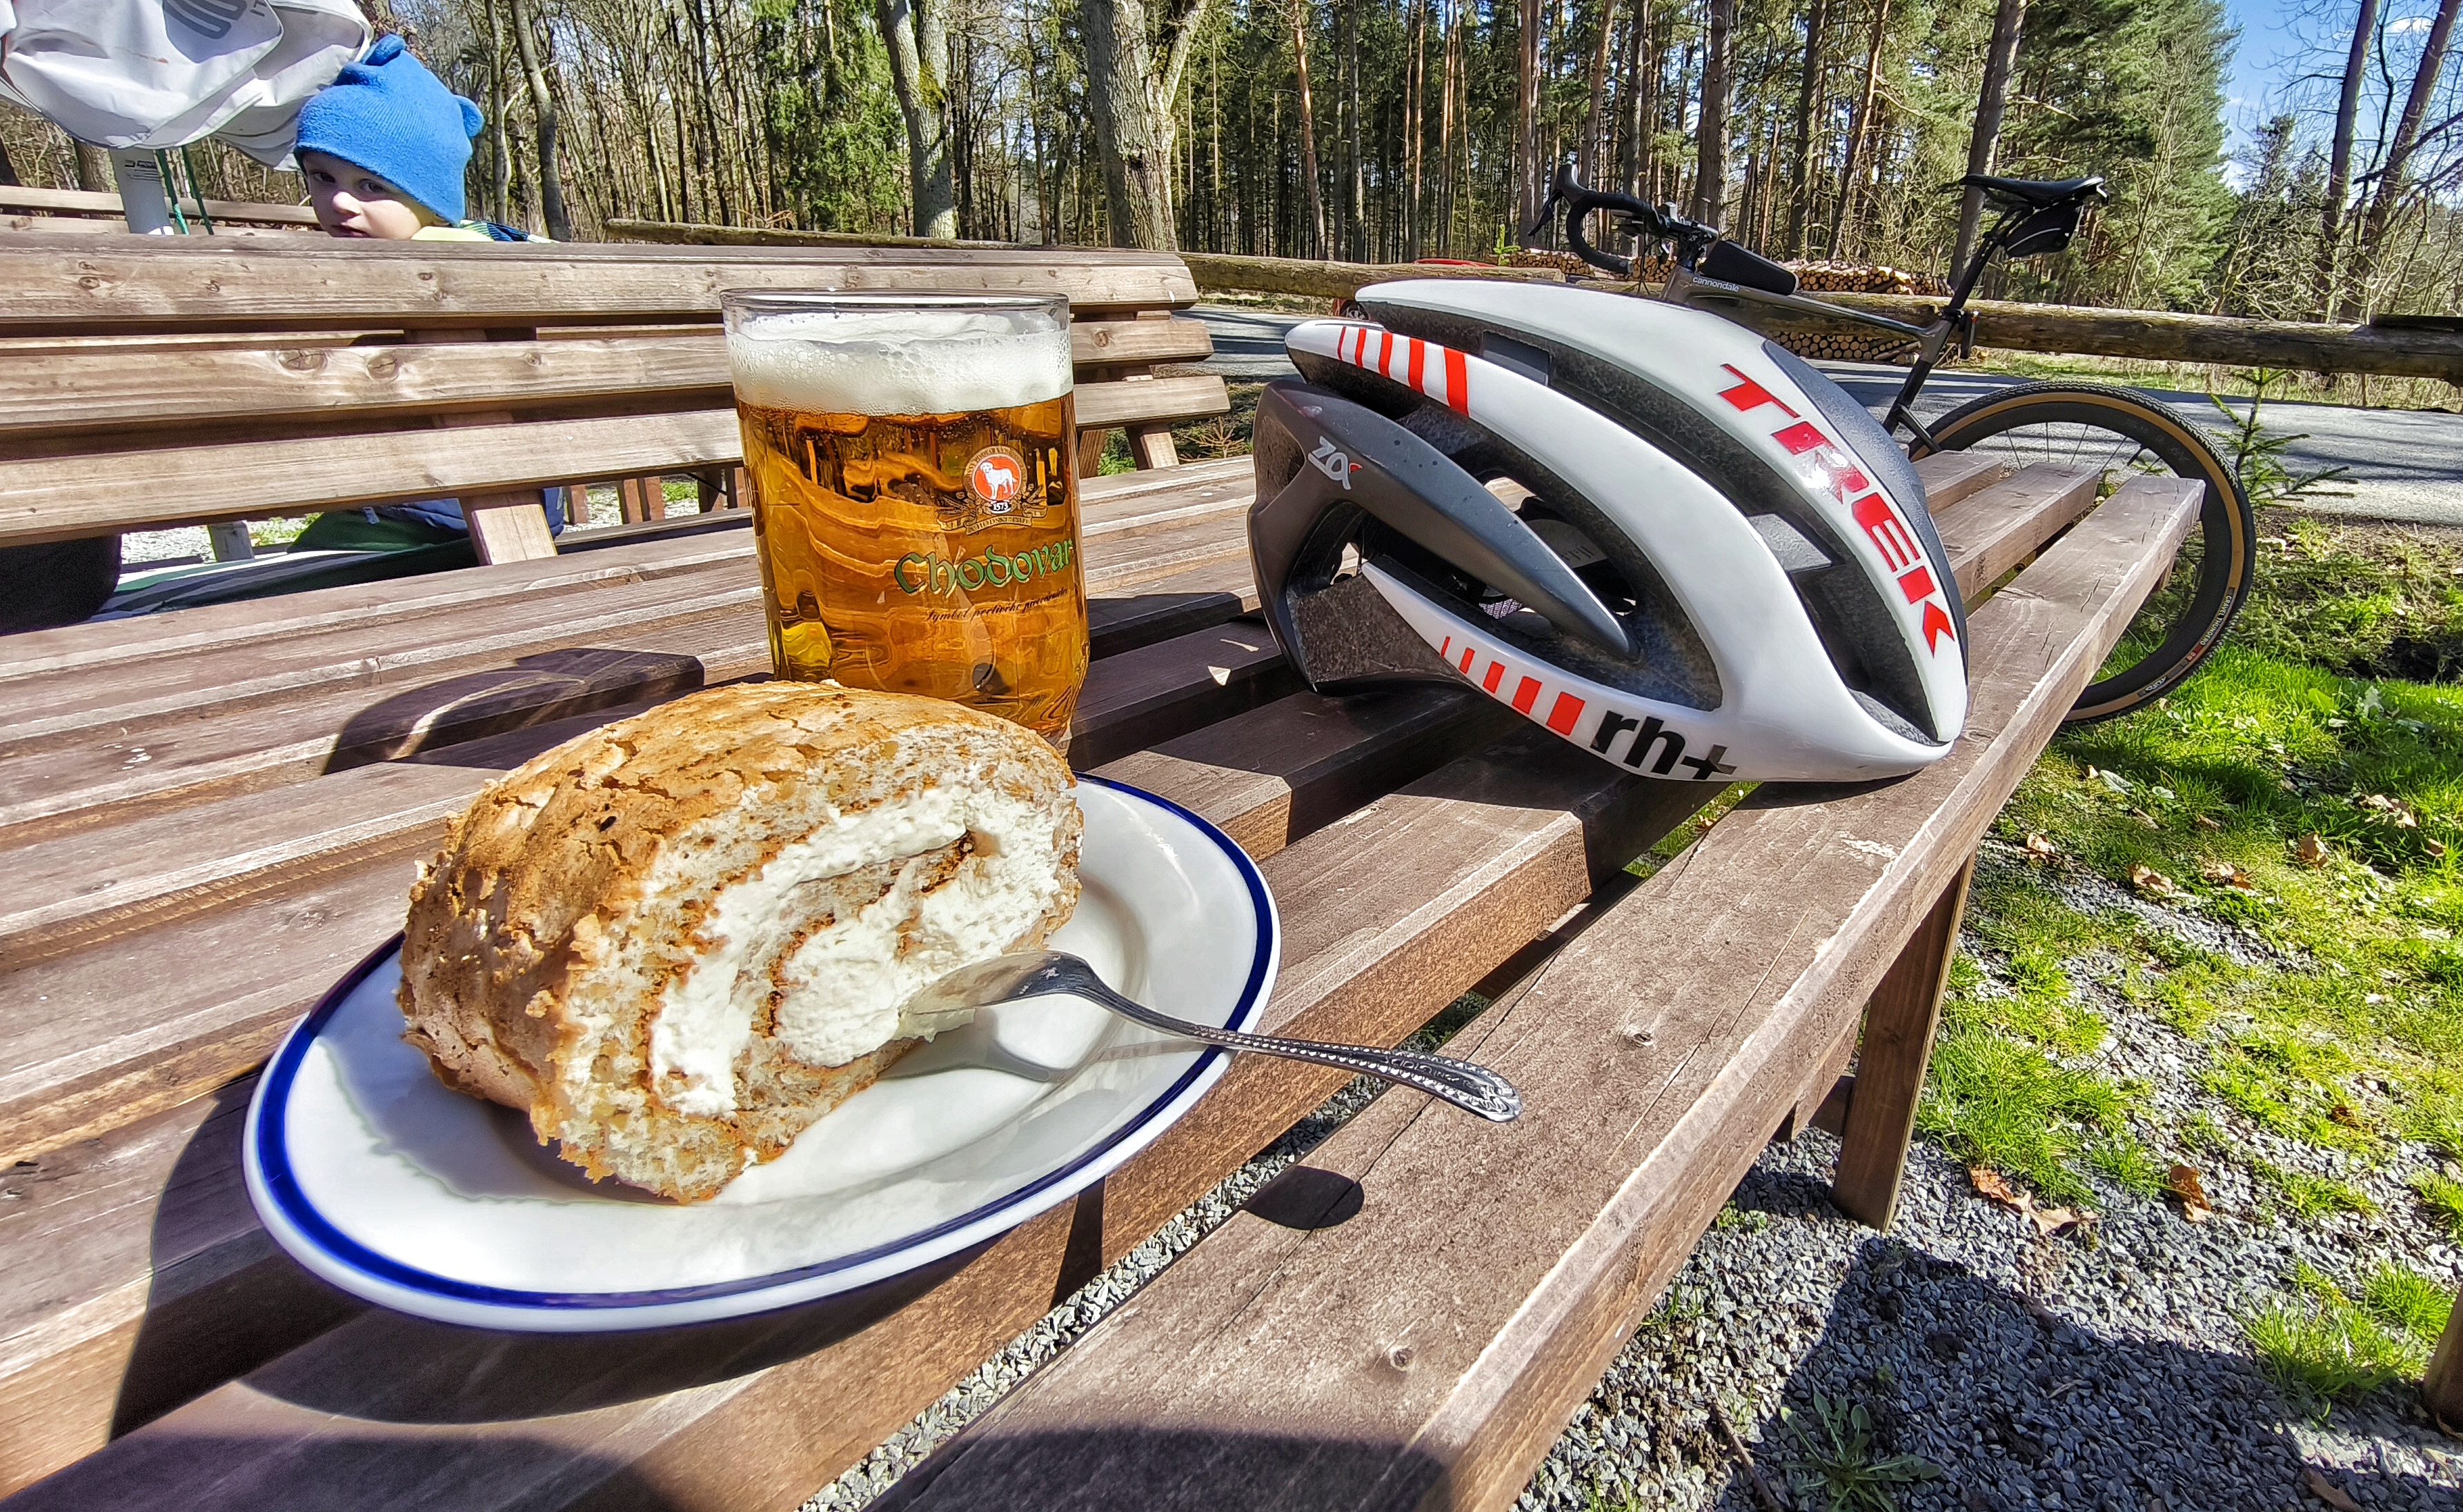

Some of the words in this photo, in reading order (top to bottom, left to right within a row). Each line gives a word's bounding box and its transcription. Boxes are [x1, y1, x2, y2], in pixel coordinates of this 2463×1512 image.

[1692, 277, 1739, 292] cannondale
[993, 501, 1009, 510] 1573
[1717, 363, 1955, 658] TREK
[894, 537, 1074, 599] Chodovar
[2217, 595, 2233, 619] GRAVEL
[1589, 710, 1738, 780] rh+
